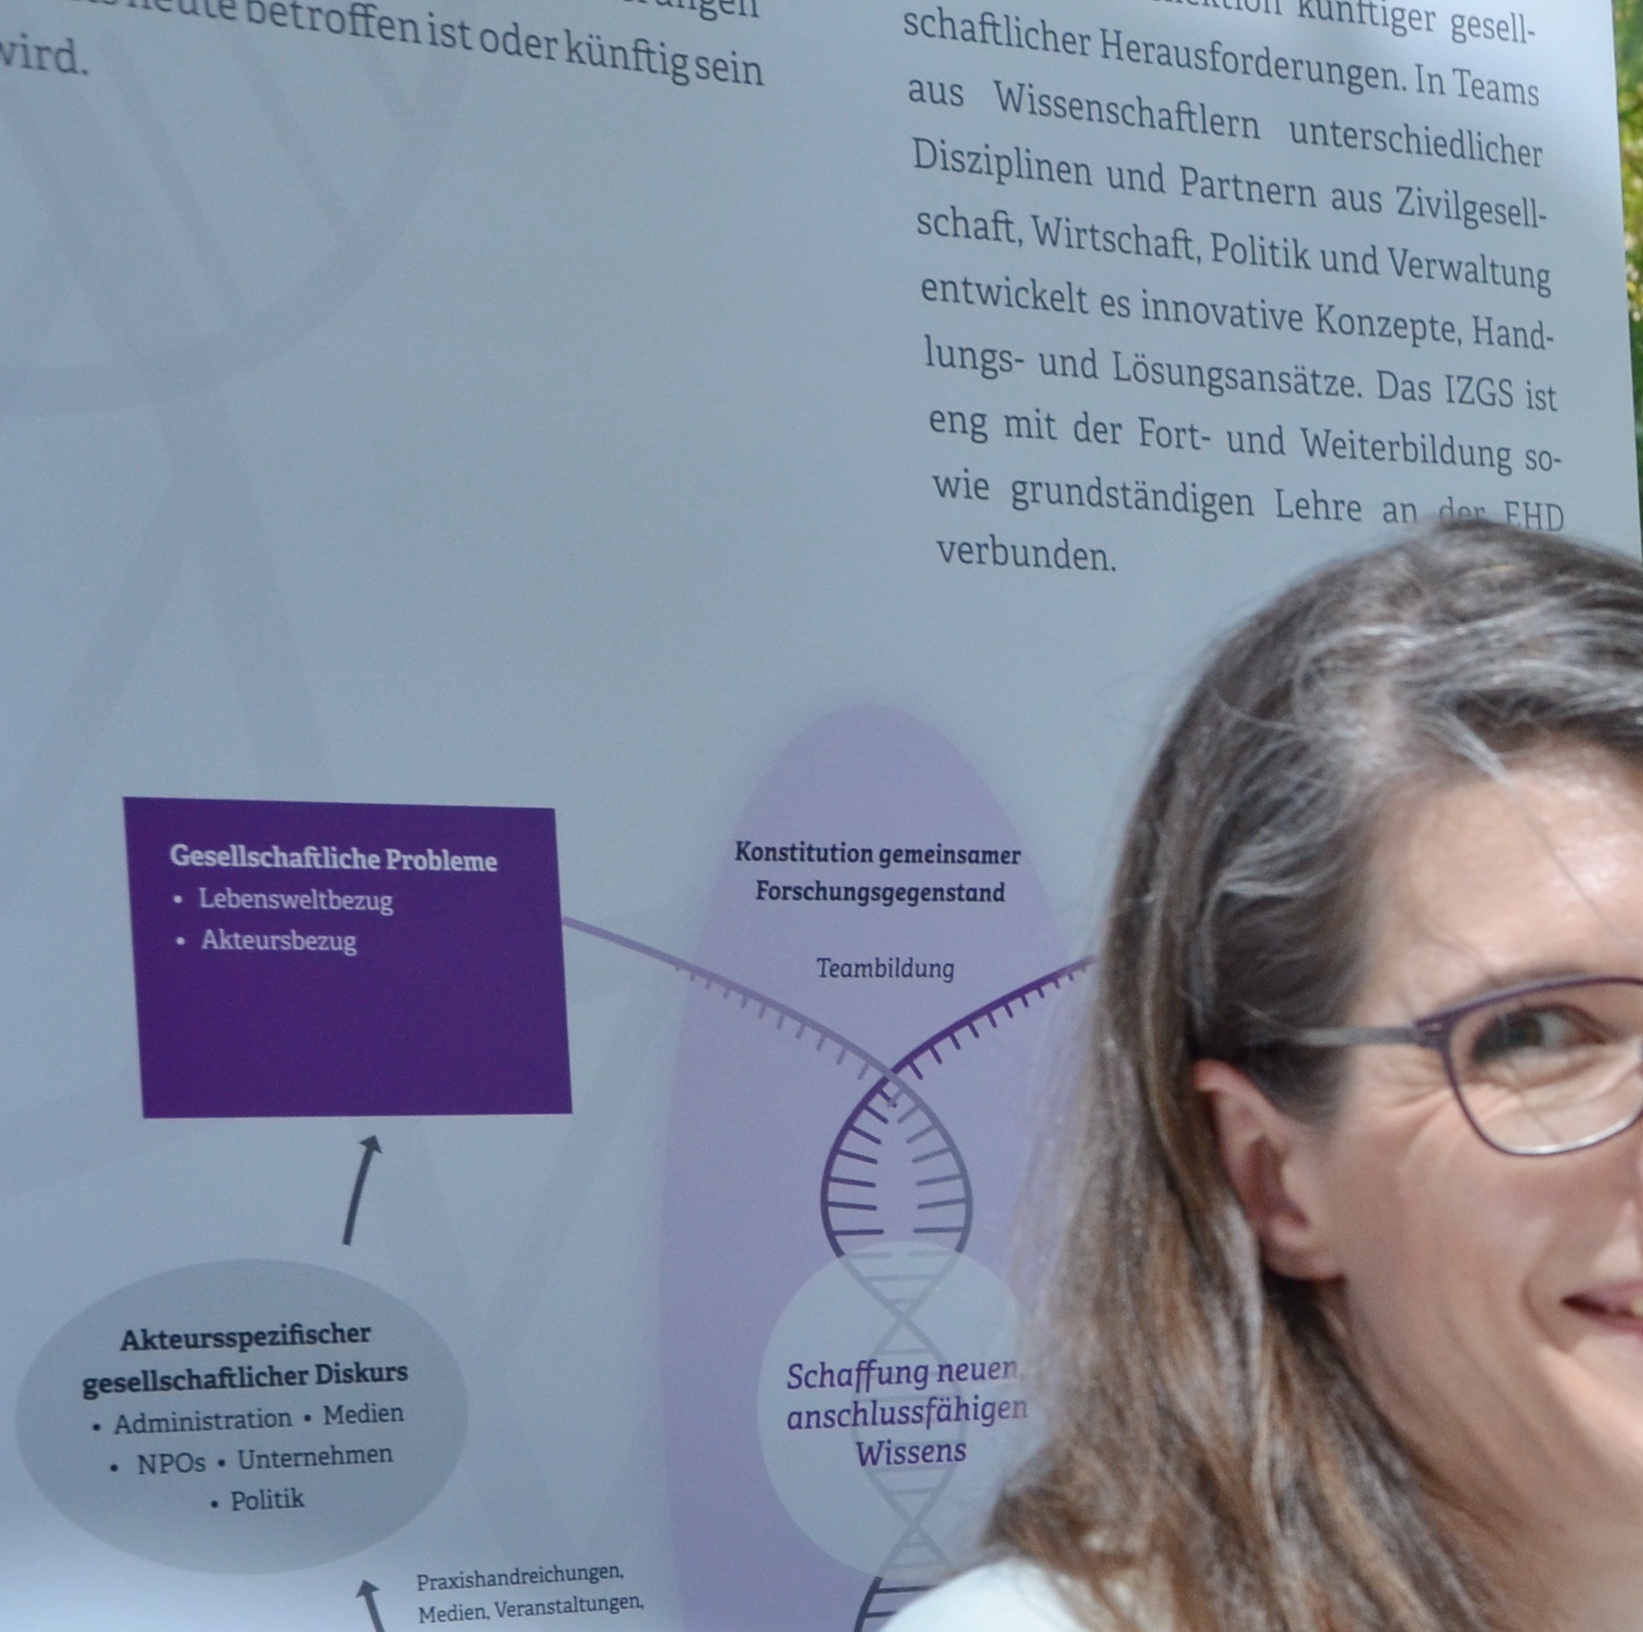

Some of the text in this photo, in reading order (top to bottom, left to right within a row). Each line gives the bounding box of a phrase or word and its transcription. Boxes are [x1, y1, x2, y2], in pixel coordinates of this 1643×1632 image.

[246, 0, 422, 44] betroffen
[428, 12, 473, 50] ist
[480, 22, 558, 60] oder
[564, 29, 690, 86] künftig
[696, 51, 764, 86] sein
[1451, 12, 1535, 43] gesell-
[904, 6, 1539, 106] schaftlicher Herausforderungen. In Teams
[909, 80, 1542, 167] aus Wissenschaftlern unterschiedlicher
[913, 137, 1546, 230] Disziplinen und Partnern aus Zivilgesell-
[918, 205, 1551, 298] schaft, Wirtschaft, Politik und Verwaltung
[922, 276, 1554, 350] entwickelt es innovative Konzepte, Hand-
[925, 334, 1557, 411] lungs- und Lösungsansätze. Das IZGS ist
[930, 408, 1561, 476] eng mit der Fort- und Weiterbildung so-
[933, 468, 989, 500] wie
[1012, 476, 1254, 522] grundständigen
[1275, 489, 1361, 521] Lehre
[1383, 502, 1416, 523] an
[937, 534, 1116, 571] verbunden.
[170, 844, 497, 872] Gesellschaftliche Probleme
[735, 841, 1021, 869] Konstitution gemeinsamer
[199, 887, 394, 916] Lebensweltbezug
[756, 880, 1005, 907] Forschungsgegenstand
[201, 928, 357, 956] Akteursbezug
[817, 957, 954, 983] Teambildung
[120, 1322, 371, 1353] Akteursspezifischer
[83, 1361, 408, 1400] gesellschaftlicher Diskurs
[787, 1359, 928, 1393] Schaffung
[114, 1403, 404, 1434] Administration Medien
[788, 1394, 1027, 1430] anschlussfähigen
[138, 1444, 393, 1475] NPOs Unternehmen
[856, 1439, 966, 1467] Wissens
[231, 1487, 305, 1511] Politik
[417, 1565, 624, 1591] Praxishandreichungen,
[419, 1596, 644, 1623] Medien, Veranstaltungen,
